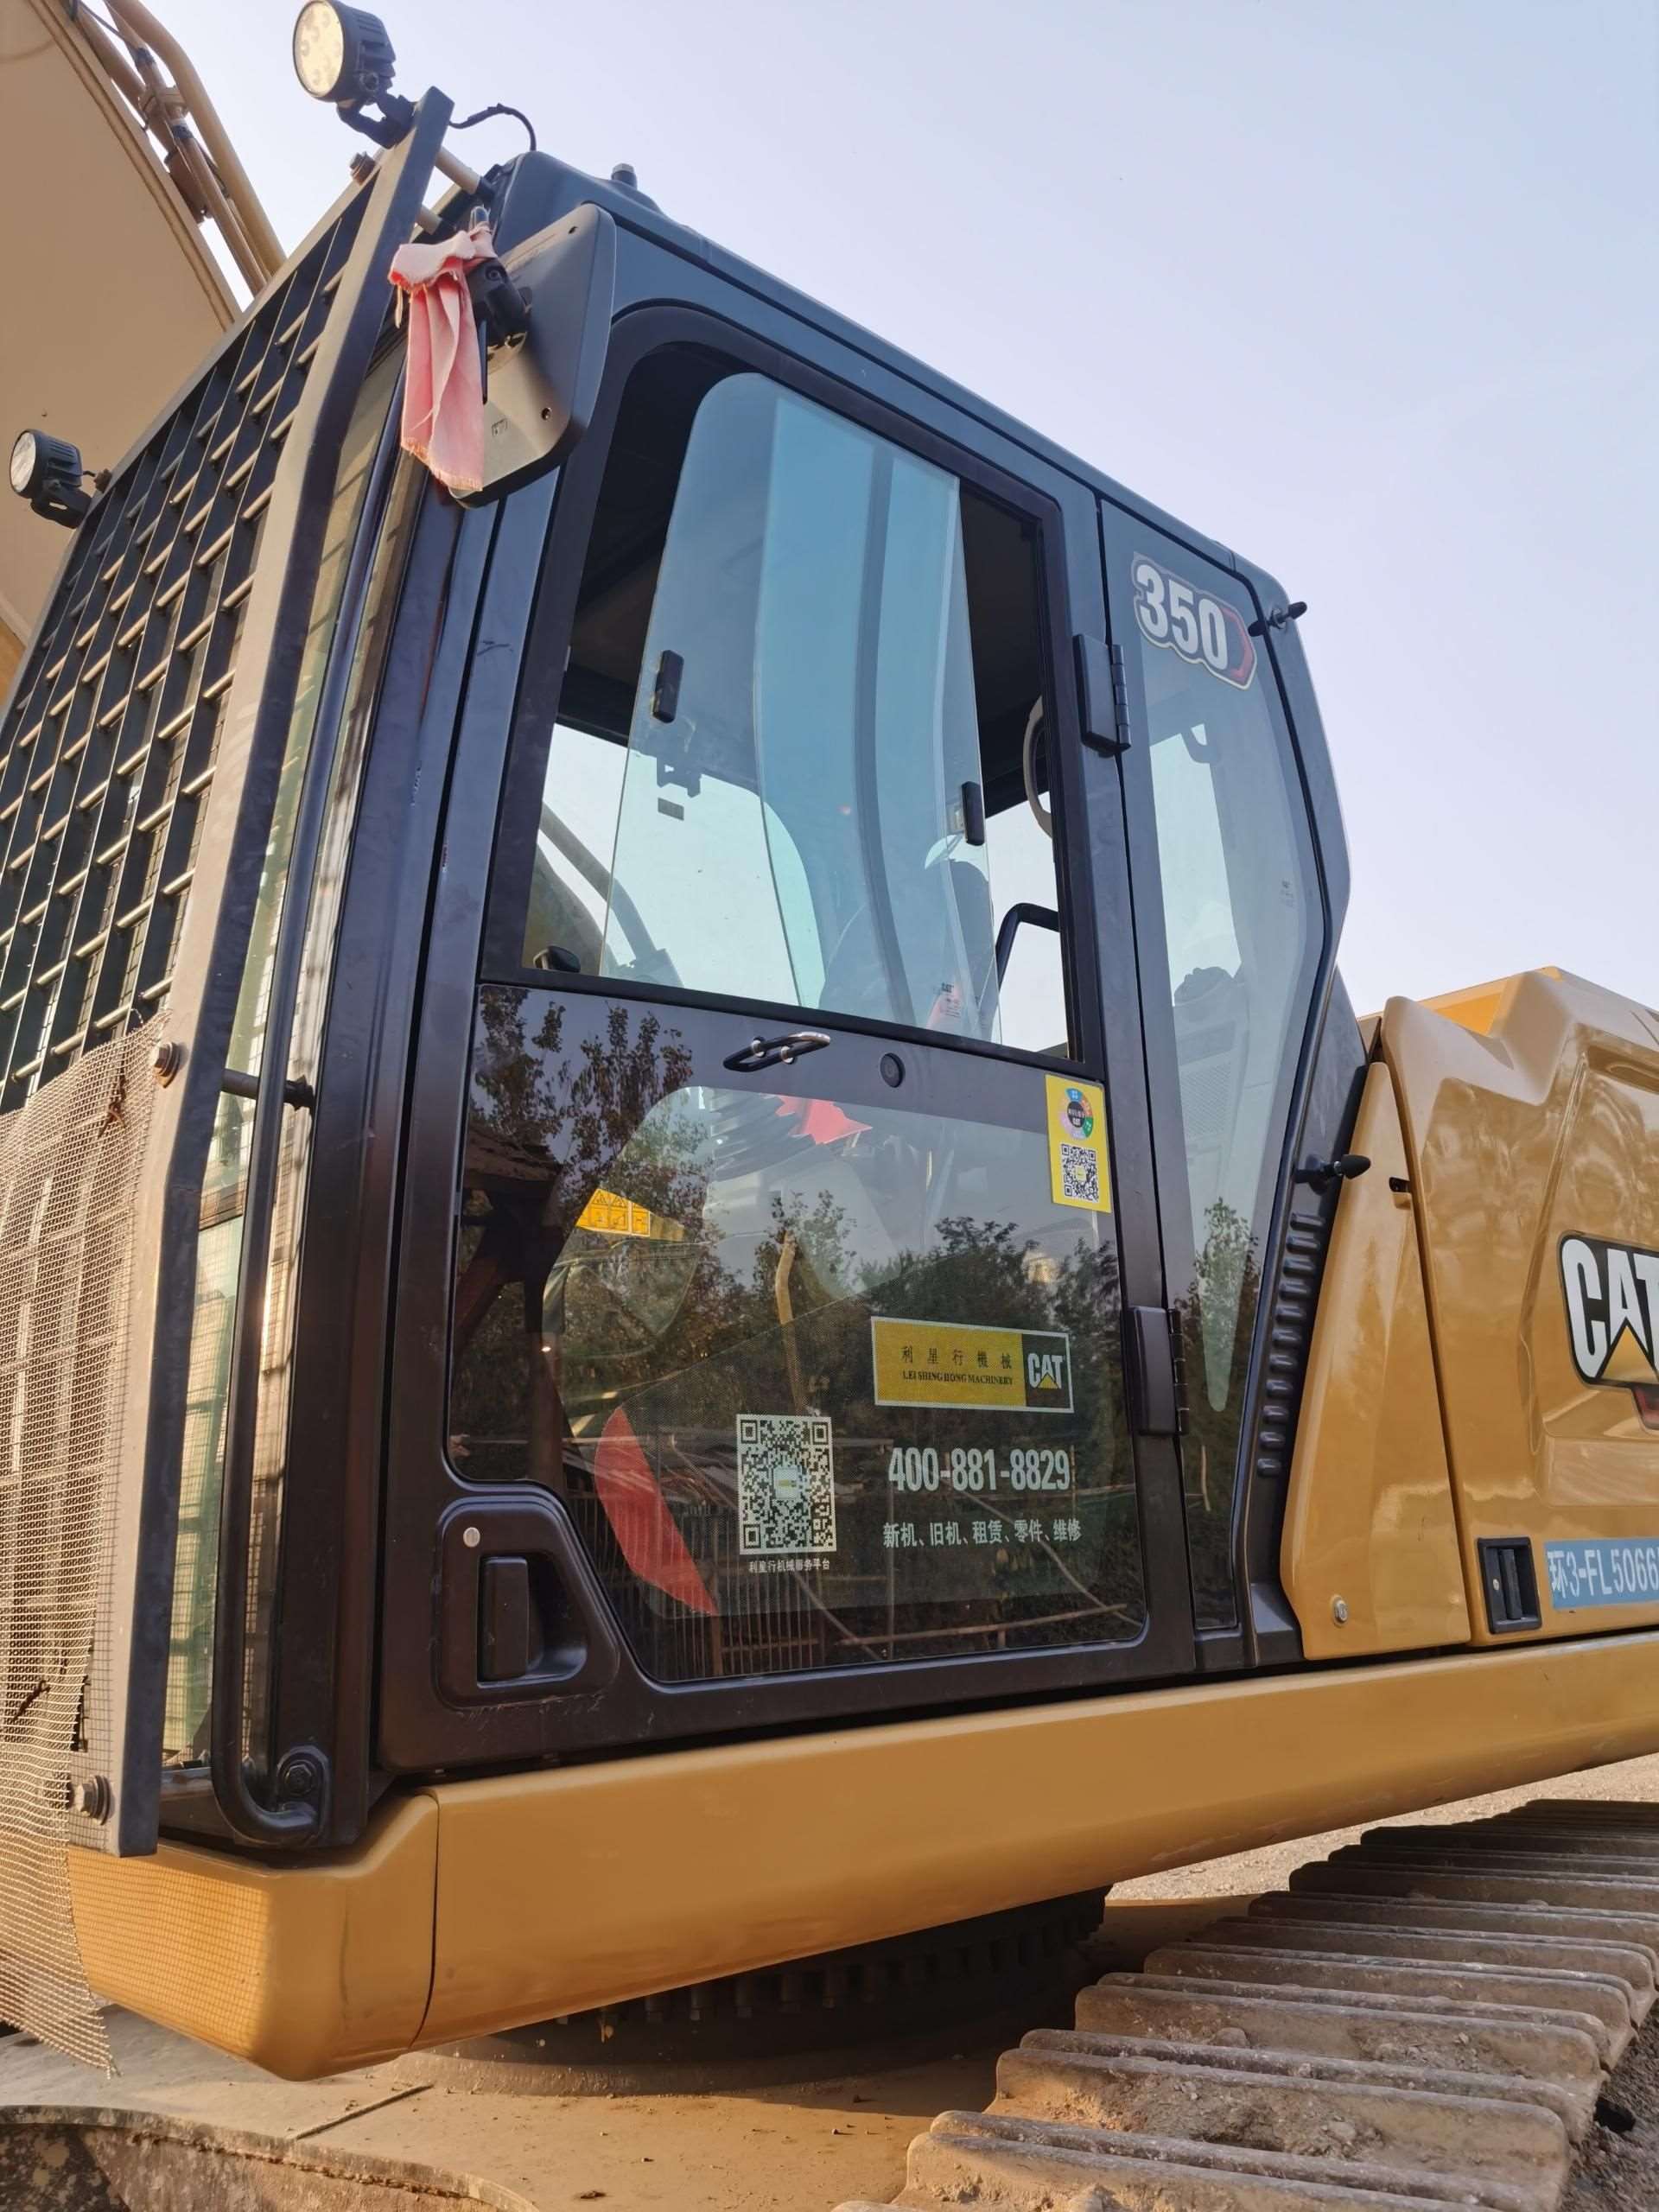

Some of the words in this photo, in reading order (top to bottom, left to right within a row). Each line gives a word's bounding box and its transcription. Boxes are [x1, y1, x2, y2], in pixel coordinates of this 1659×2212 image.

[1136, 564, 1228, 670] 350
[903, 1370, 916, 1380] LEI
[918, 1371, 943, 1382] SHING
[944, 1372, 967, 1383] HONG
[968, 1374, 1013, 1385] MACHINERY
[1027, 1353, 1063, 1389] CAT
[888, 1447, 1071, 1491] 400-881-8829
[1547, 1548, 1659, 1599] 环3-FL5066
